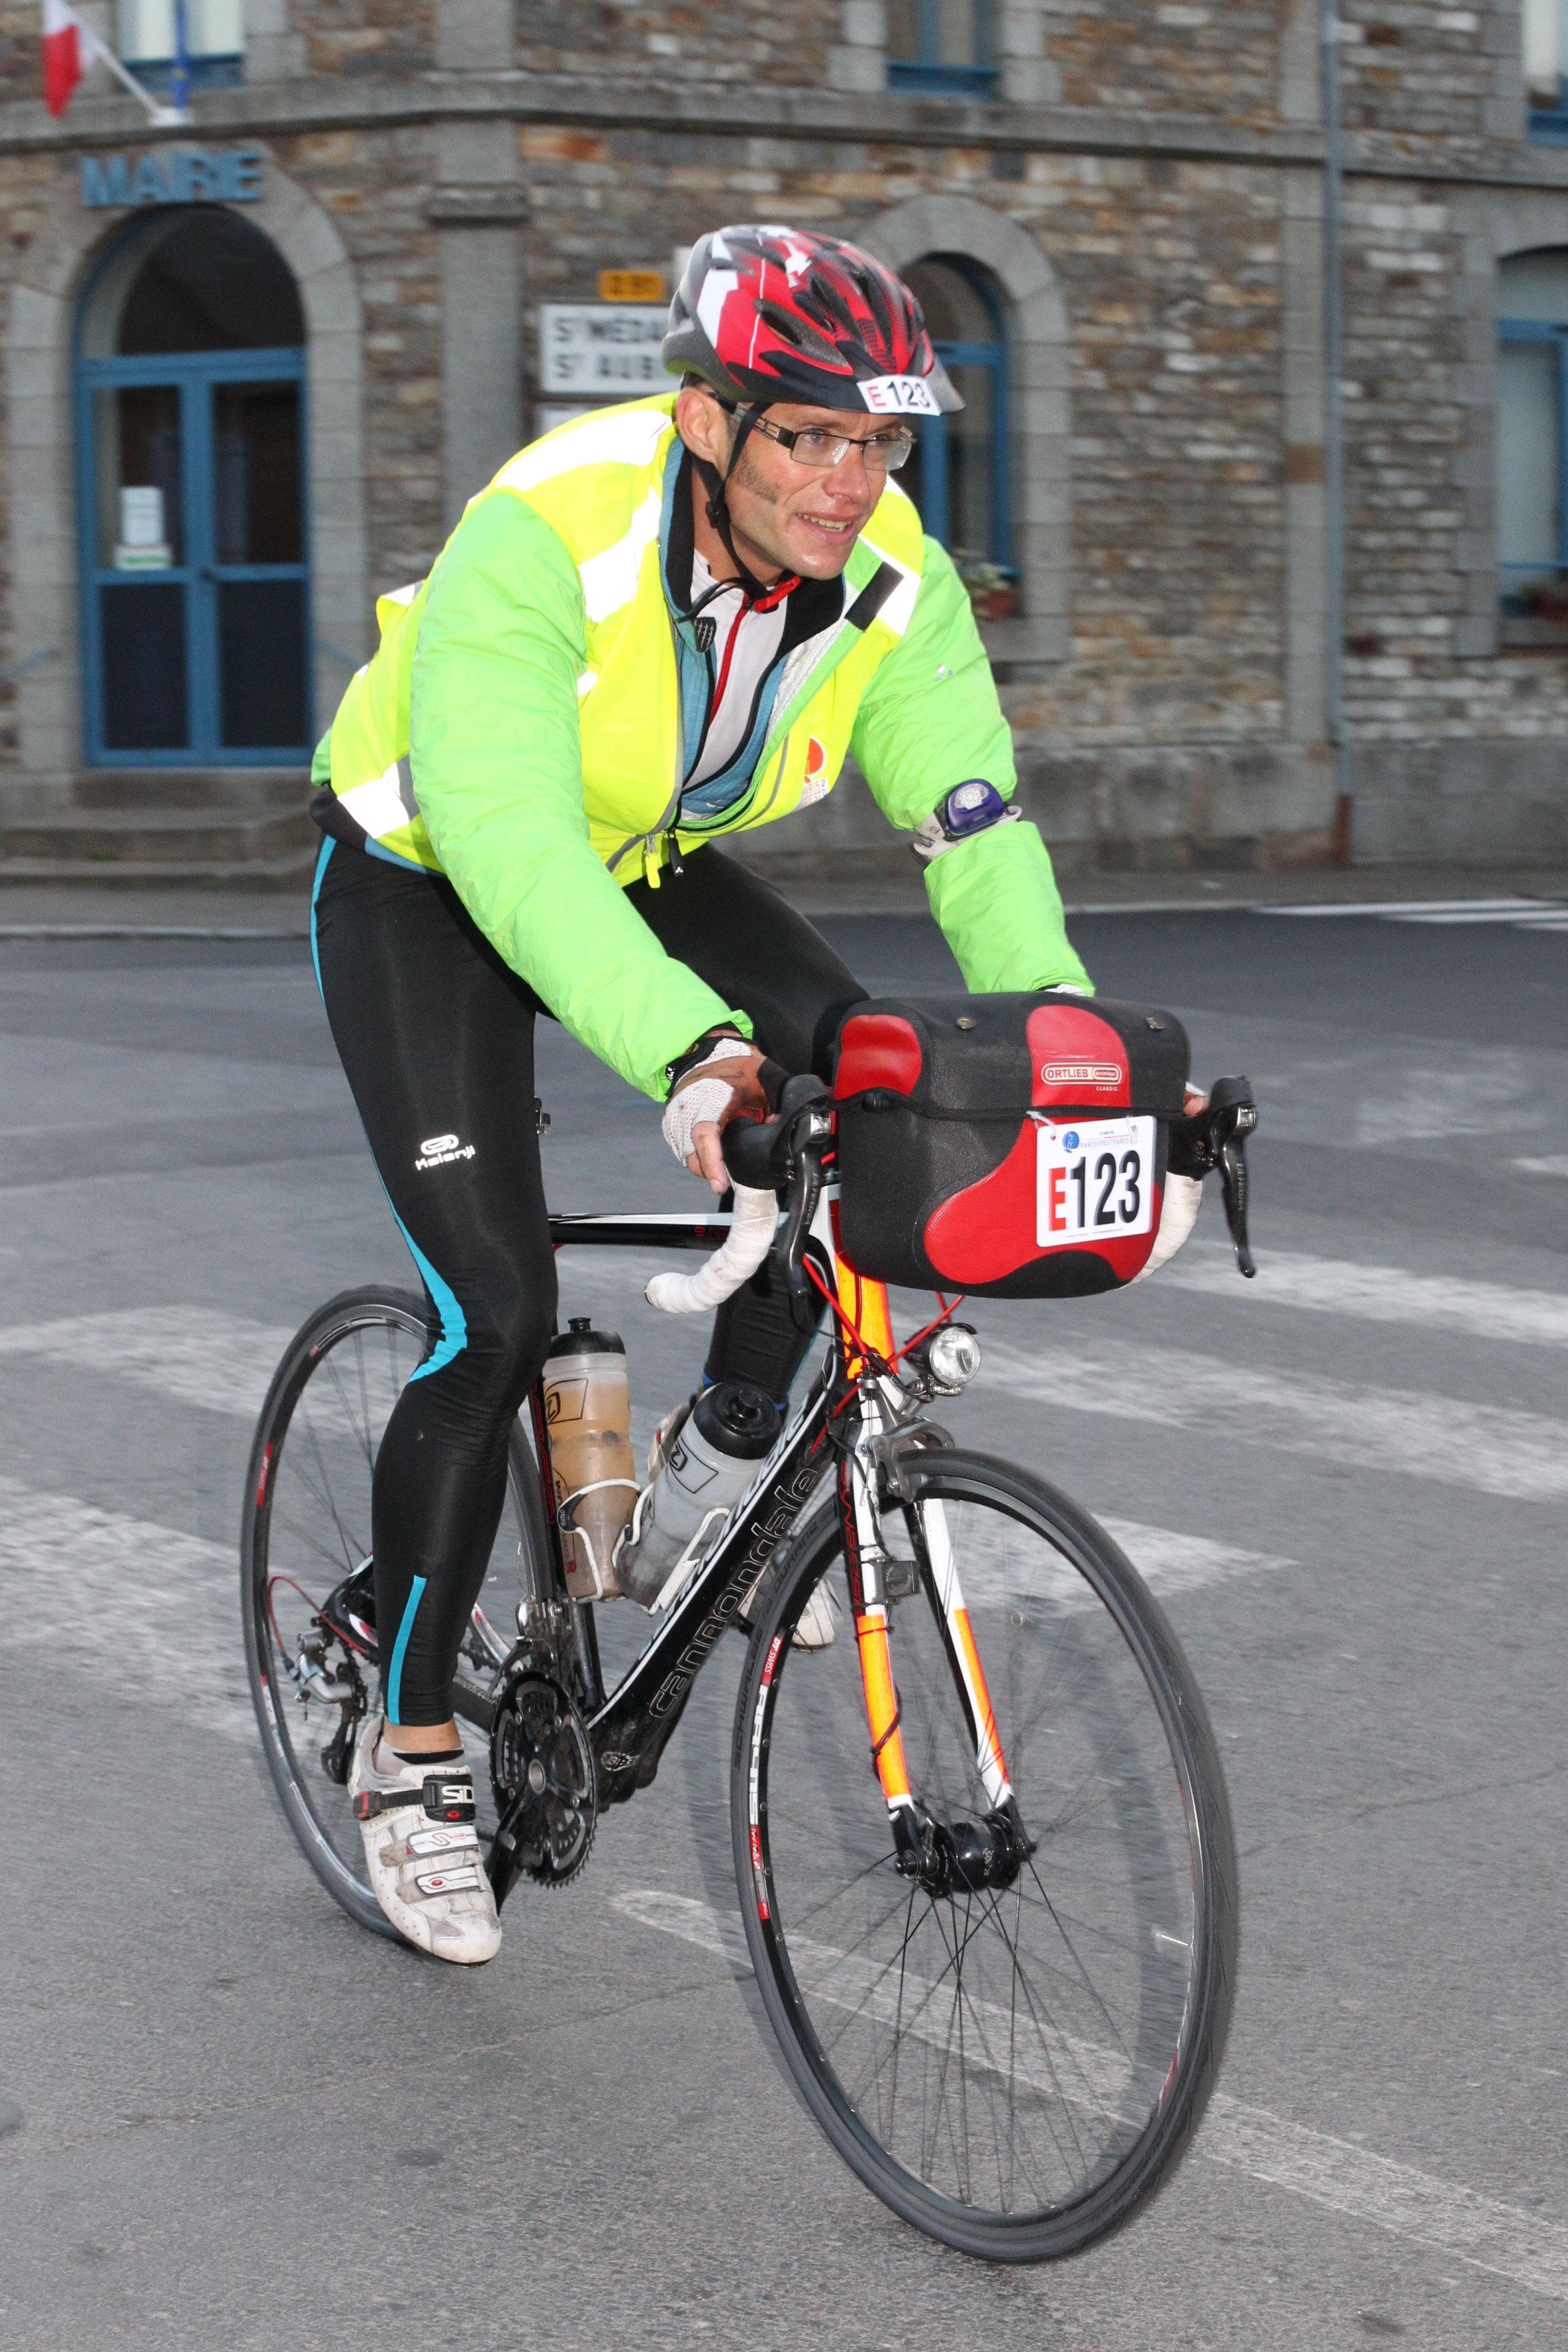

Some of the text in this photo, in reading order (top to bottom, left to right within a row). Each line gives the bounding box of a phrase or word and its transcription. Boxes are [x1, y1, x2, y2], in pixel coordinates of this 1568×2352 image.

[80, 150, 262, 207] MAIRE
[1048, 1068, 1089, 1079] ORTLIEB
[1049, 1150, 1141, 1232] E123
[649, 1467, 822, 1719] cannondale
[764, 1649, 777, 1675] SWISS
